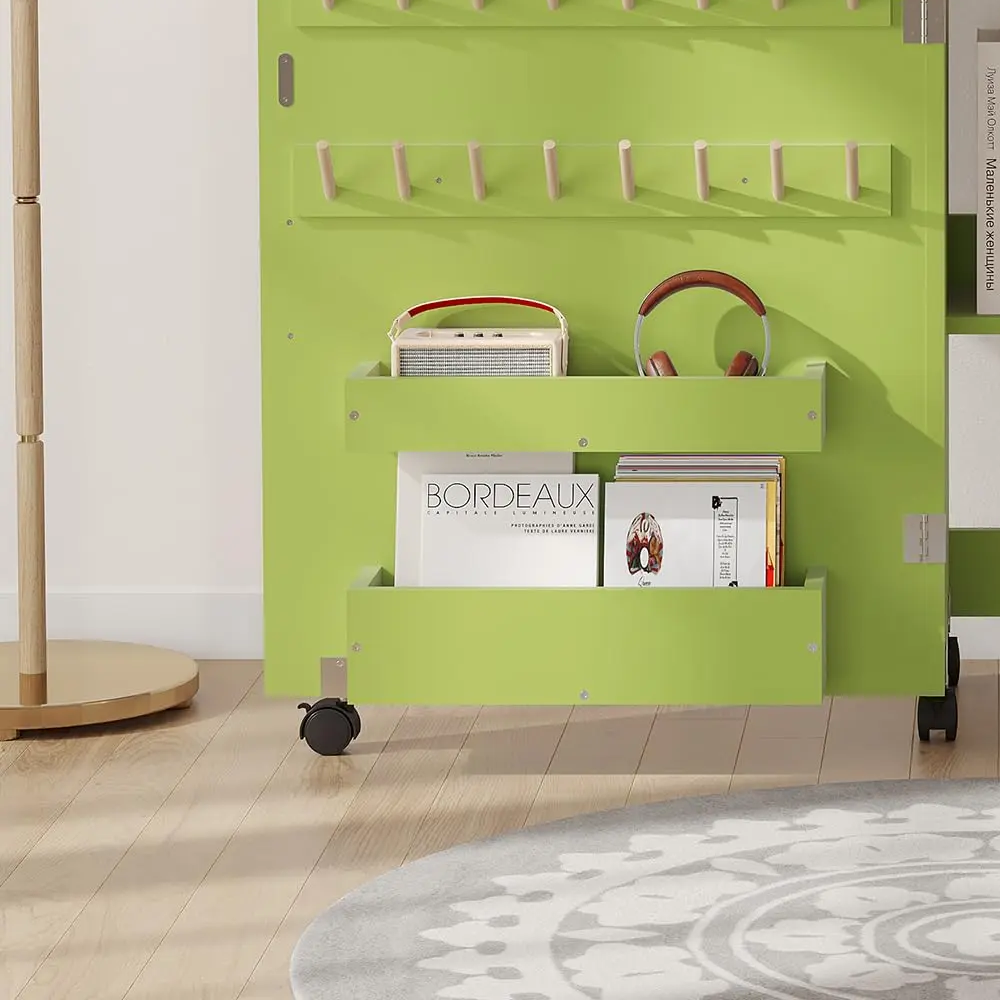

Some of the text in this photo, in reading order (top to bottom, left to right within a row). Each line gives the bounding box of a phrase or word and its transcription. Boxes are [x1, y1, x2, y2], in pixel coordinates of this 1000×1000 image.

[984, 66, 997, 151] Луиза Мэй Олкотт
[983, 157, 997, 292] Маленькие женщины
[427, 482, 595, 509] BORDEAUX
